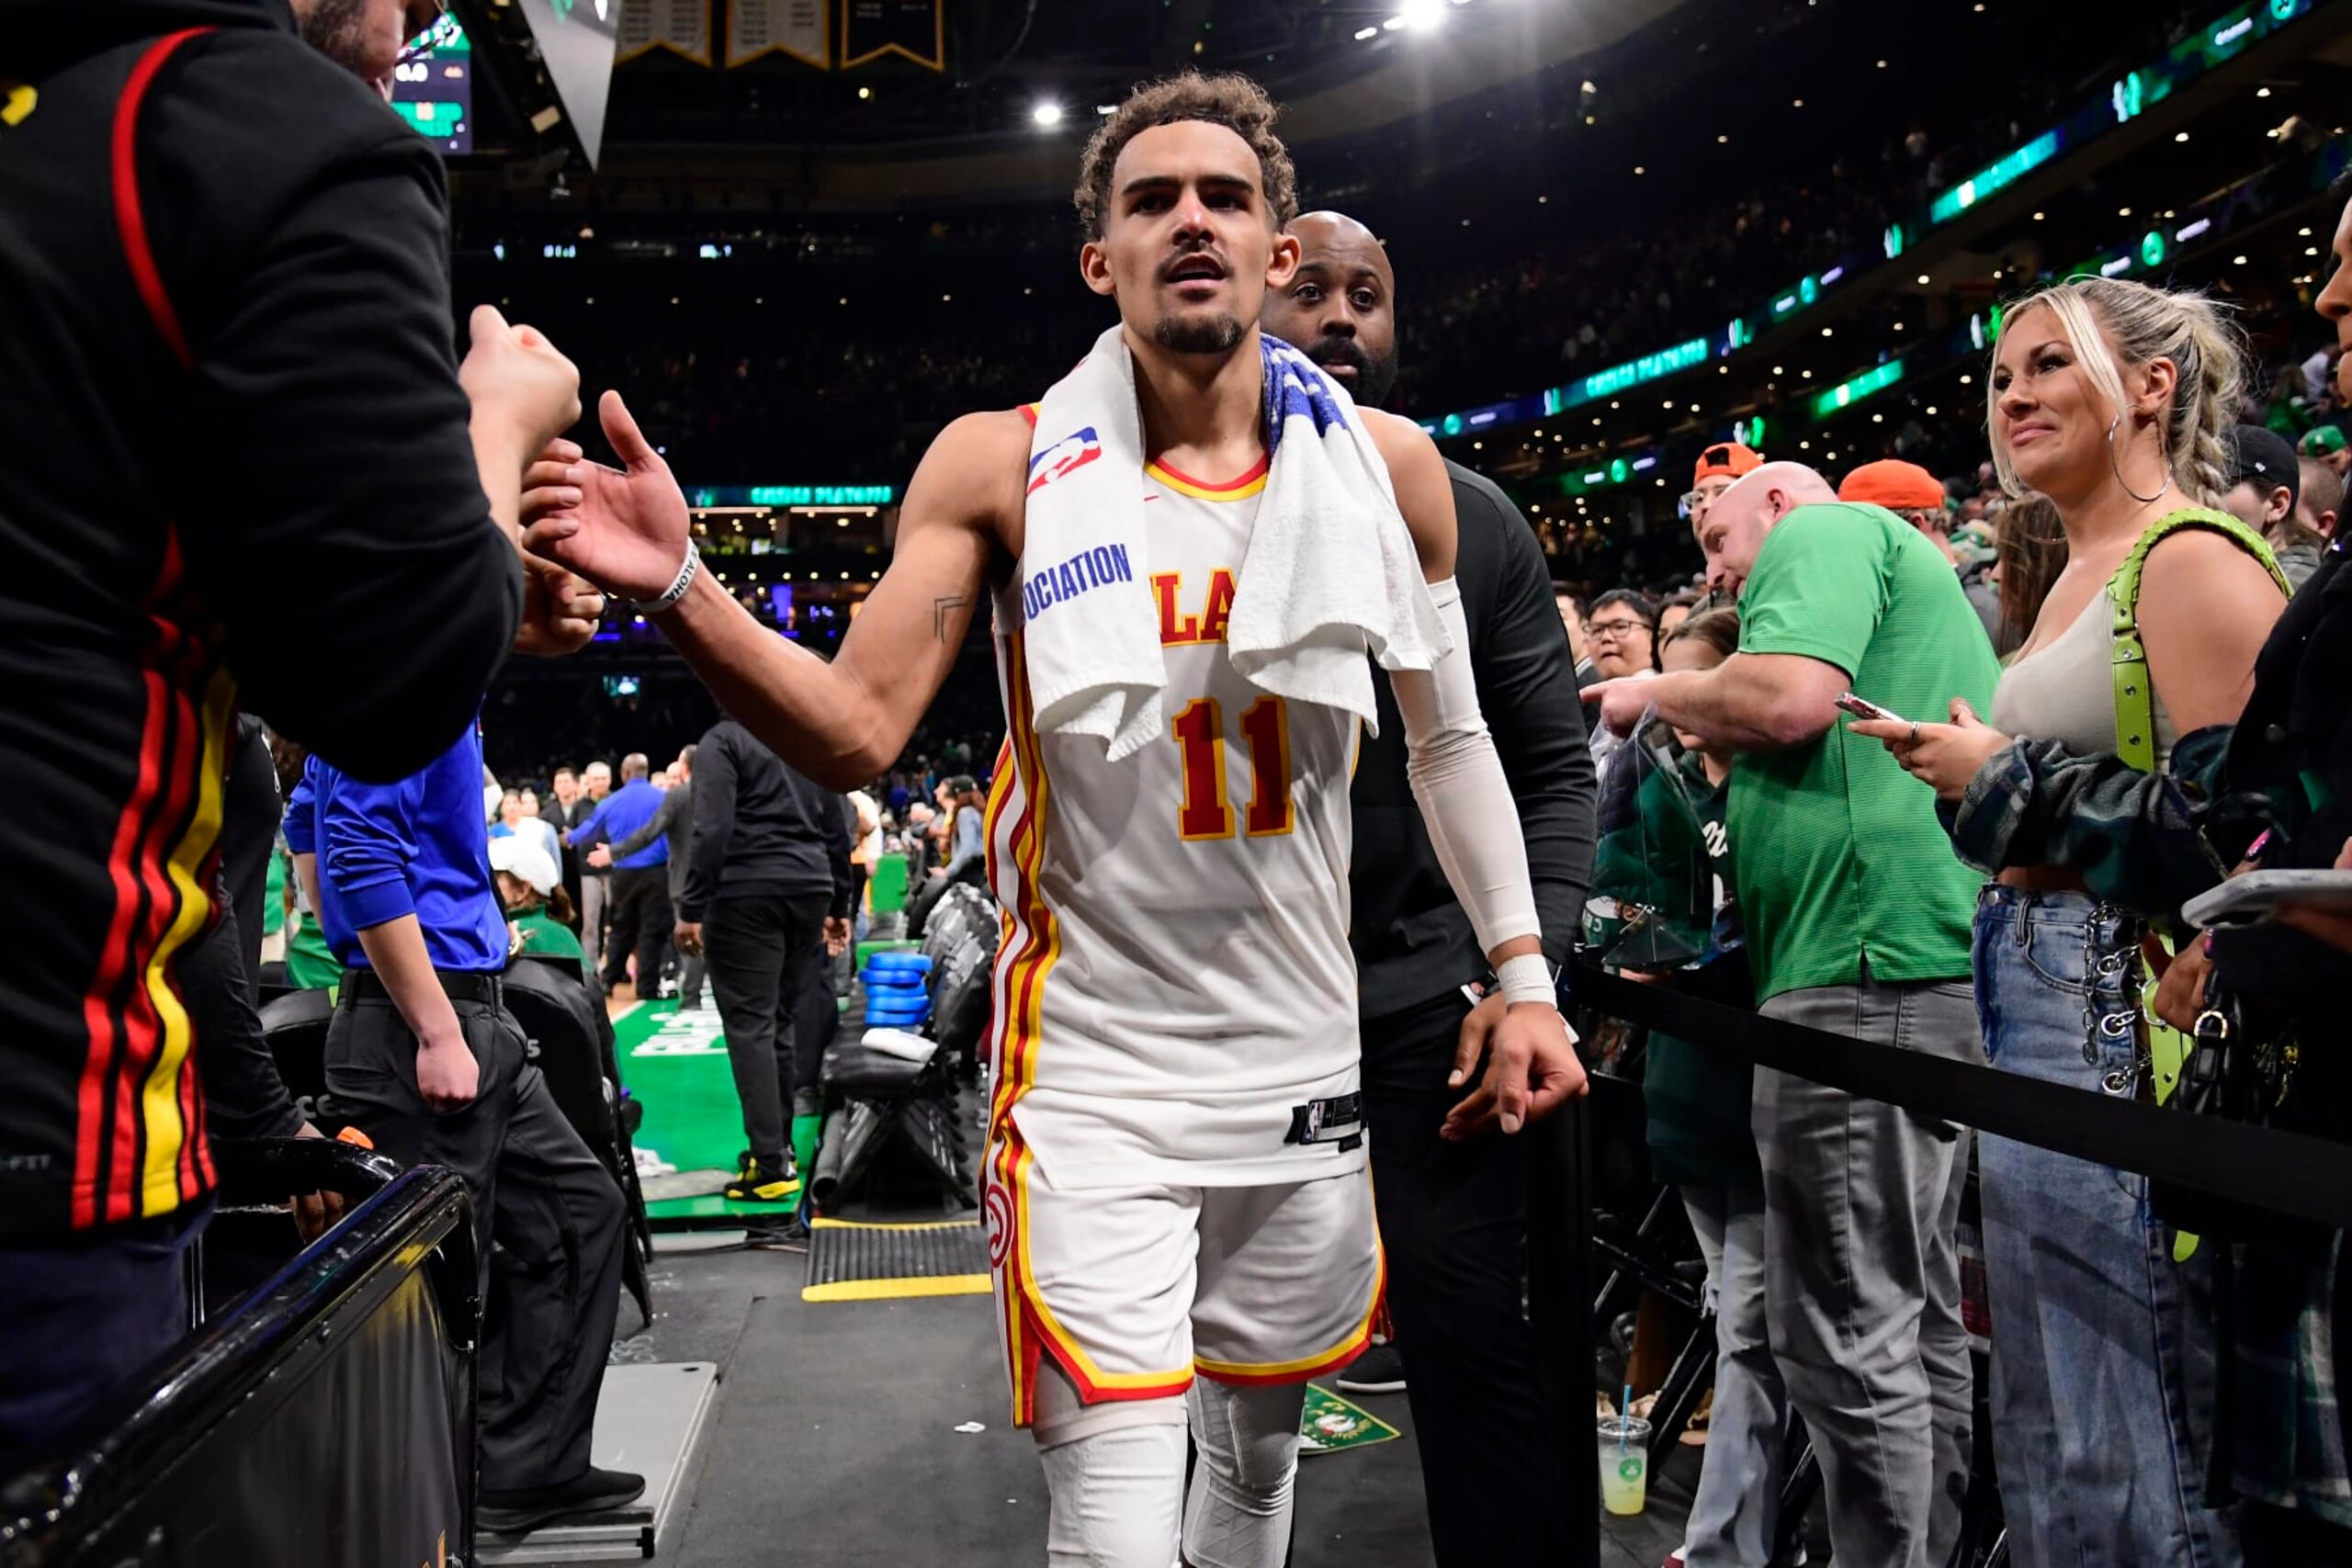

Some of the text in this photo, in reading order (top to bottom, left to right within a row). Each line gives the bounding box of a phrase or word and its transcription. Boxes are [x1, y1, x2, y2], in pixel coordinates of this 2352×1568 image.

[665, 558, 695, 602] ALOHA
[1024, 543, 1133, 620] OCIATION
[1149, 567, 1238, 649] LA
[1171, 695, 1295, 841] 11
